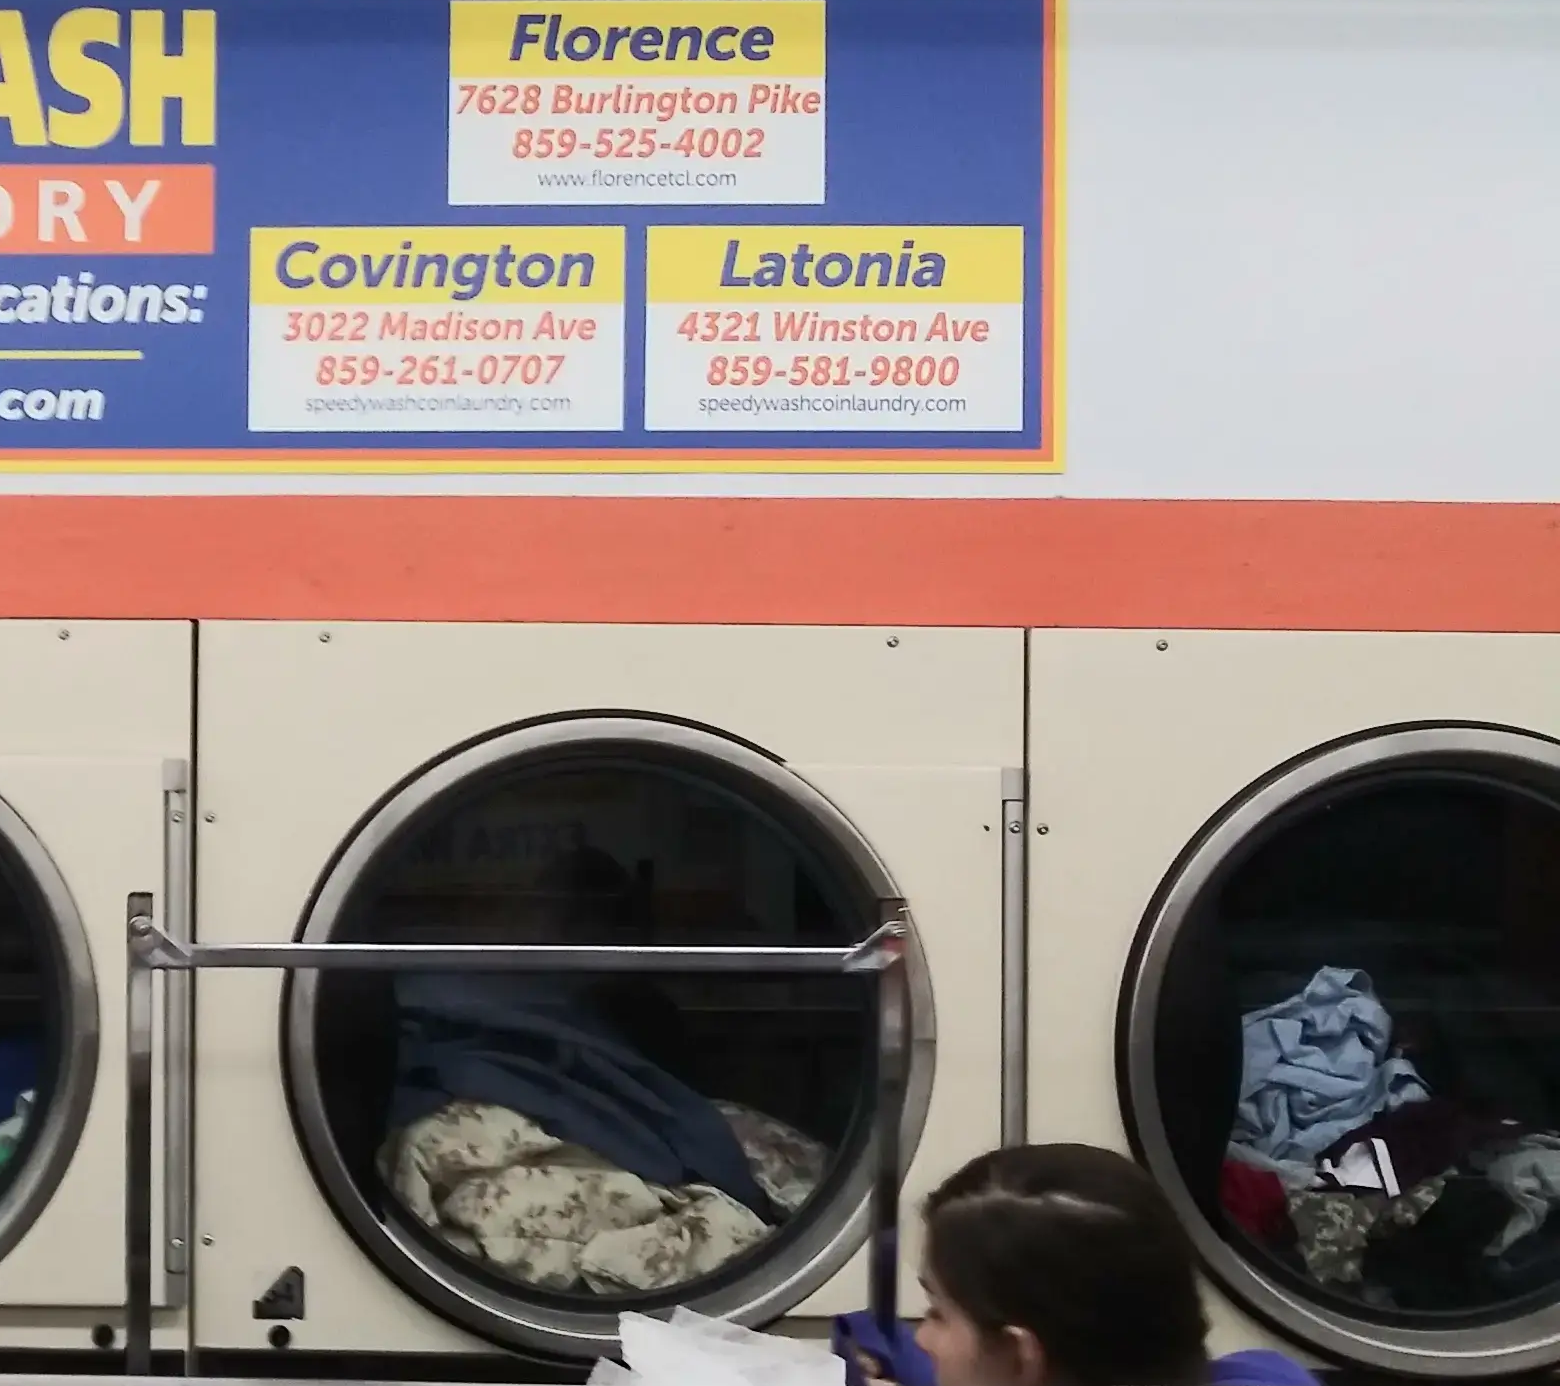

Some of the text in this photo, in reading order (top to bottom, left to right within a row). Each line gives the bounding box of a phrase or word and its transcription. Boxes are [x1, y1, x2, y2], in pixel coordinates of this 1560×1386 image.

[510, 14, 774, 61] Florence
[457, 84, 820, 122] 7628 Burlington Pike
[513, 128, 764, 158] 859-525-4002
[538, 170, 736, 186] www.florencetcl.com
[276, 241, 594, 301] Covington
[720, 240, 945, 287] Latonia
[283, 311, 596, 341] 3022 Madison Ave
[677, 312, 989, 342] 4321 Winston Ave
[317, 355, 565, 385] 859-261-0707
[707, 356, 959, 386] 859-581-9800
[699, 395, 965, 416] speedywashcoinlaundry.com
